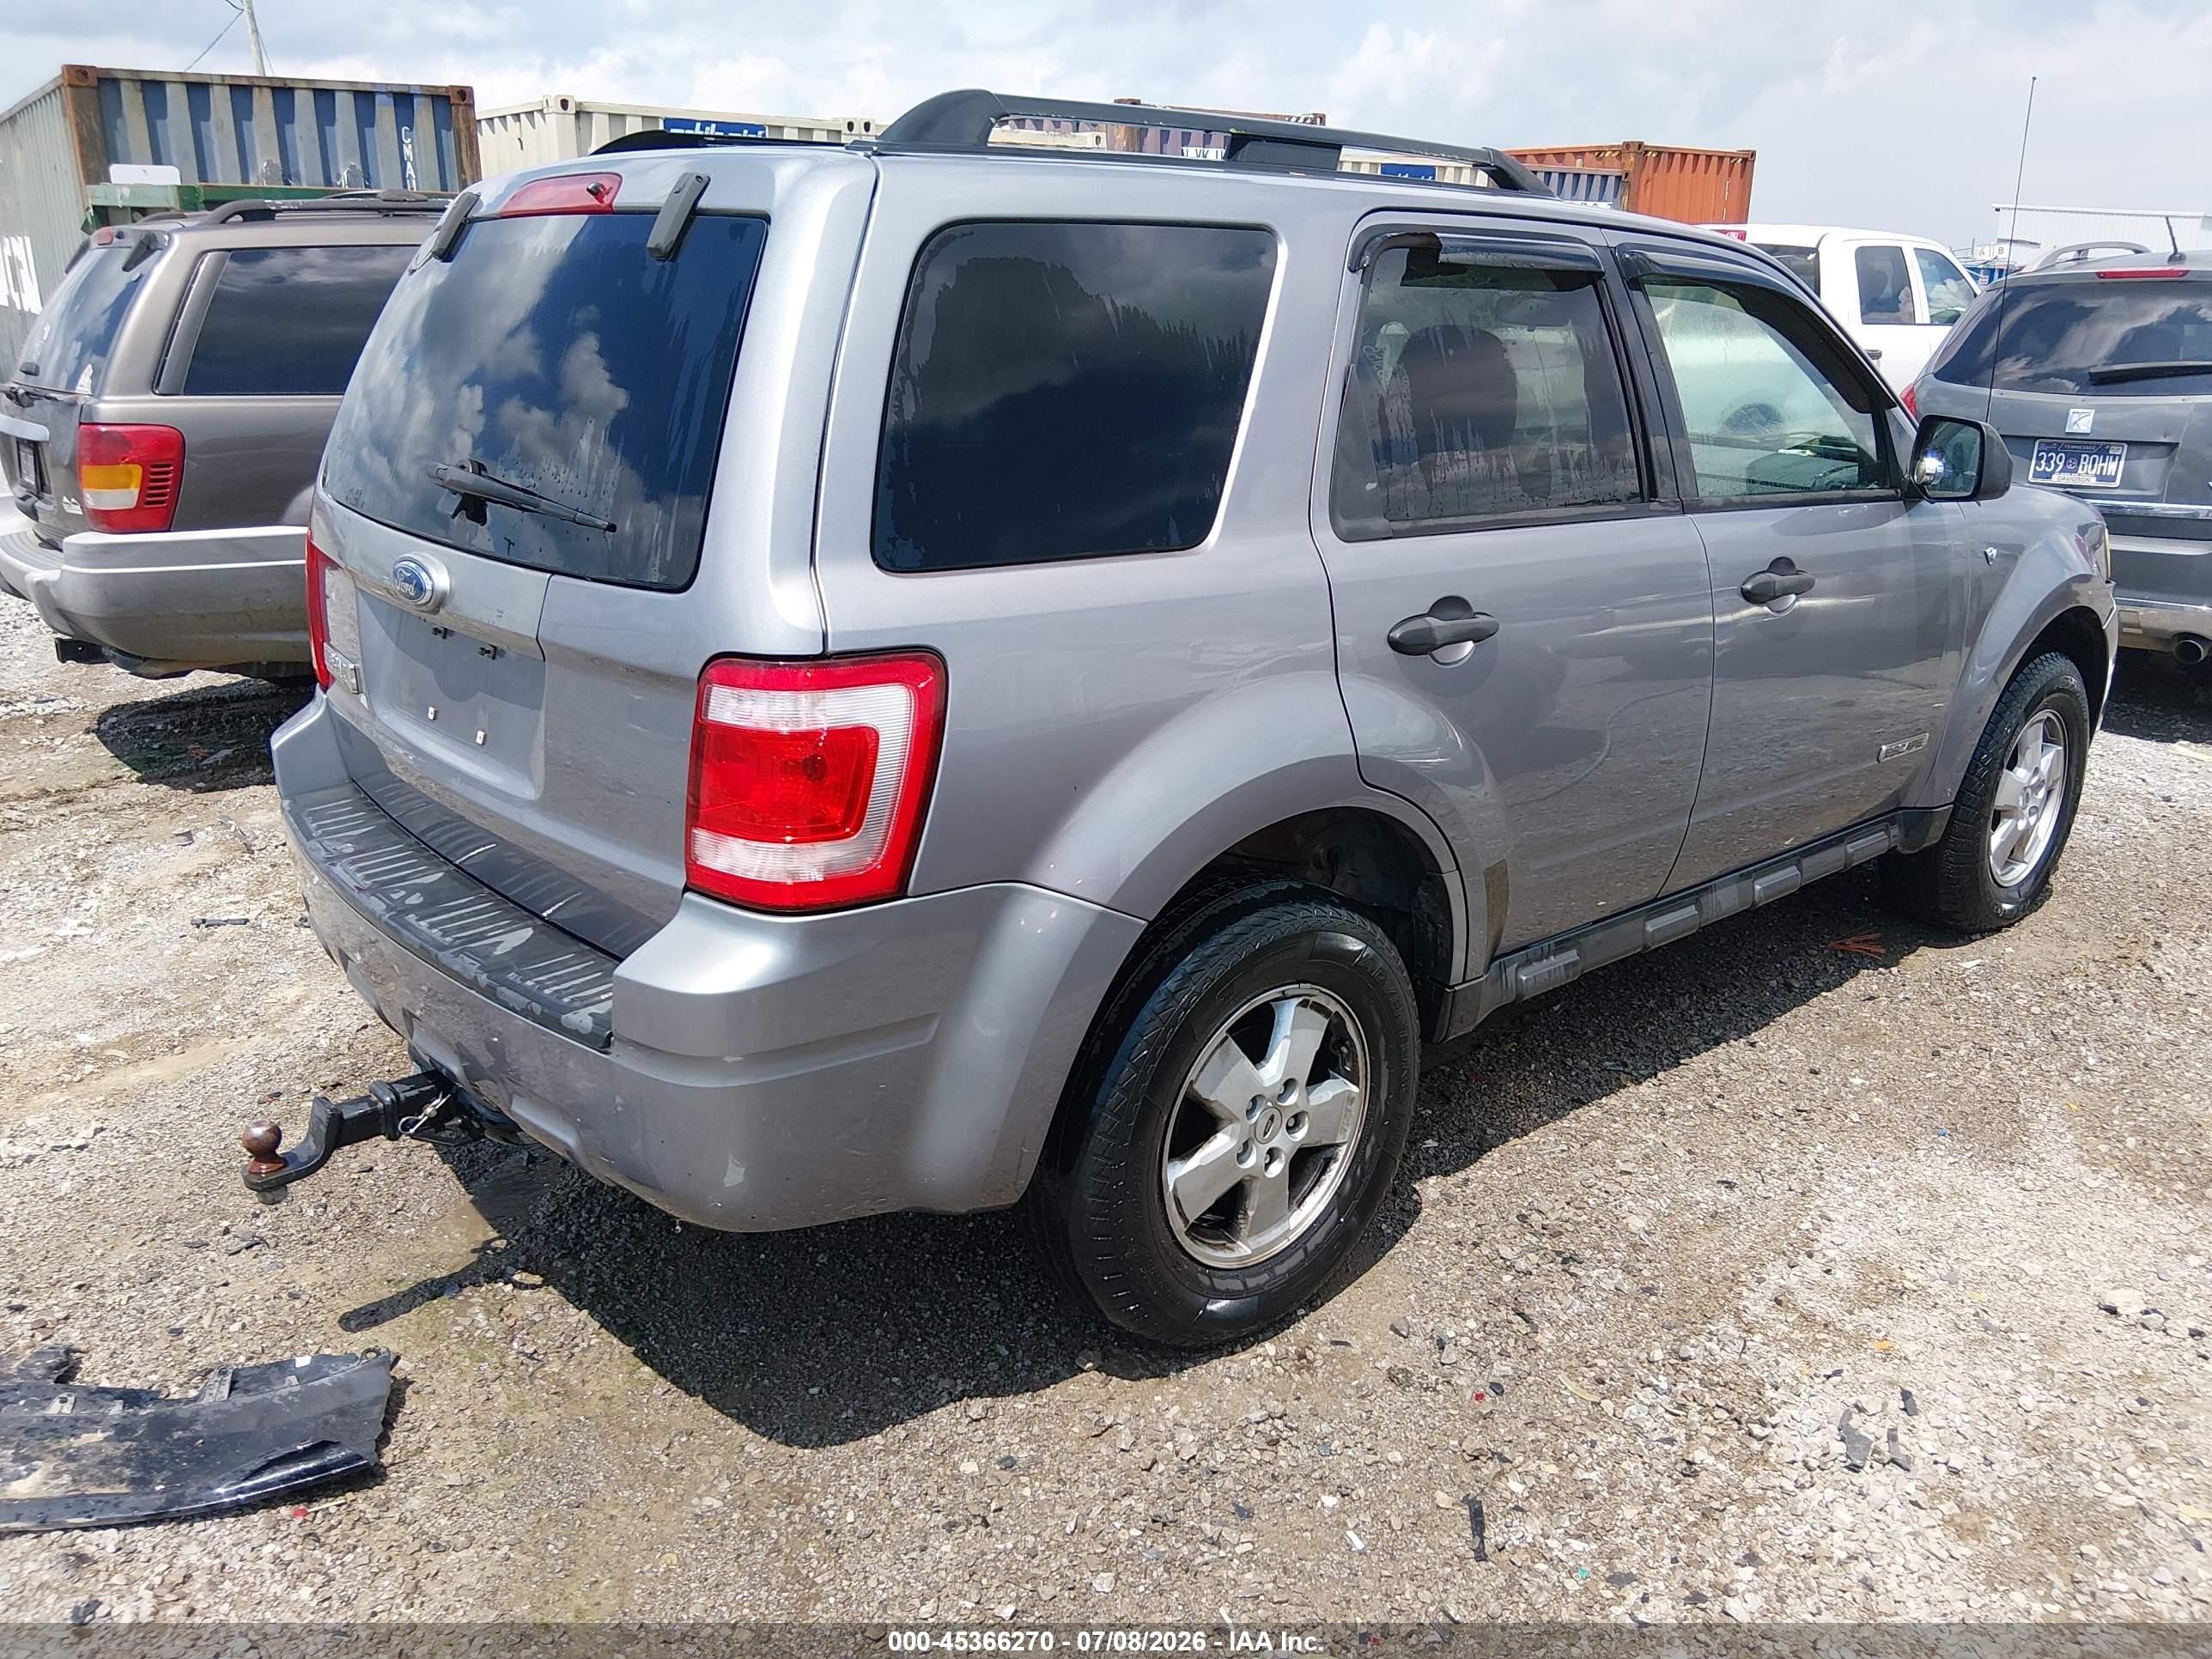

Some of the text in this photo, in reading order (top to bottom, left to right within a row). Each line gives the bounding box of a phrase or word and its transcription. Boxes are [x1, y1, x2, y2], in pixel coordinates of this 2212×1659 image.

[2036, 452, 2065, 472] 339
[2057, 475, 2091, 483] DAVIDSON
[394, 568, 417, 596] Ford
